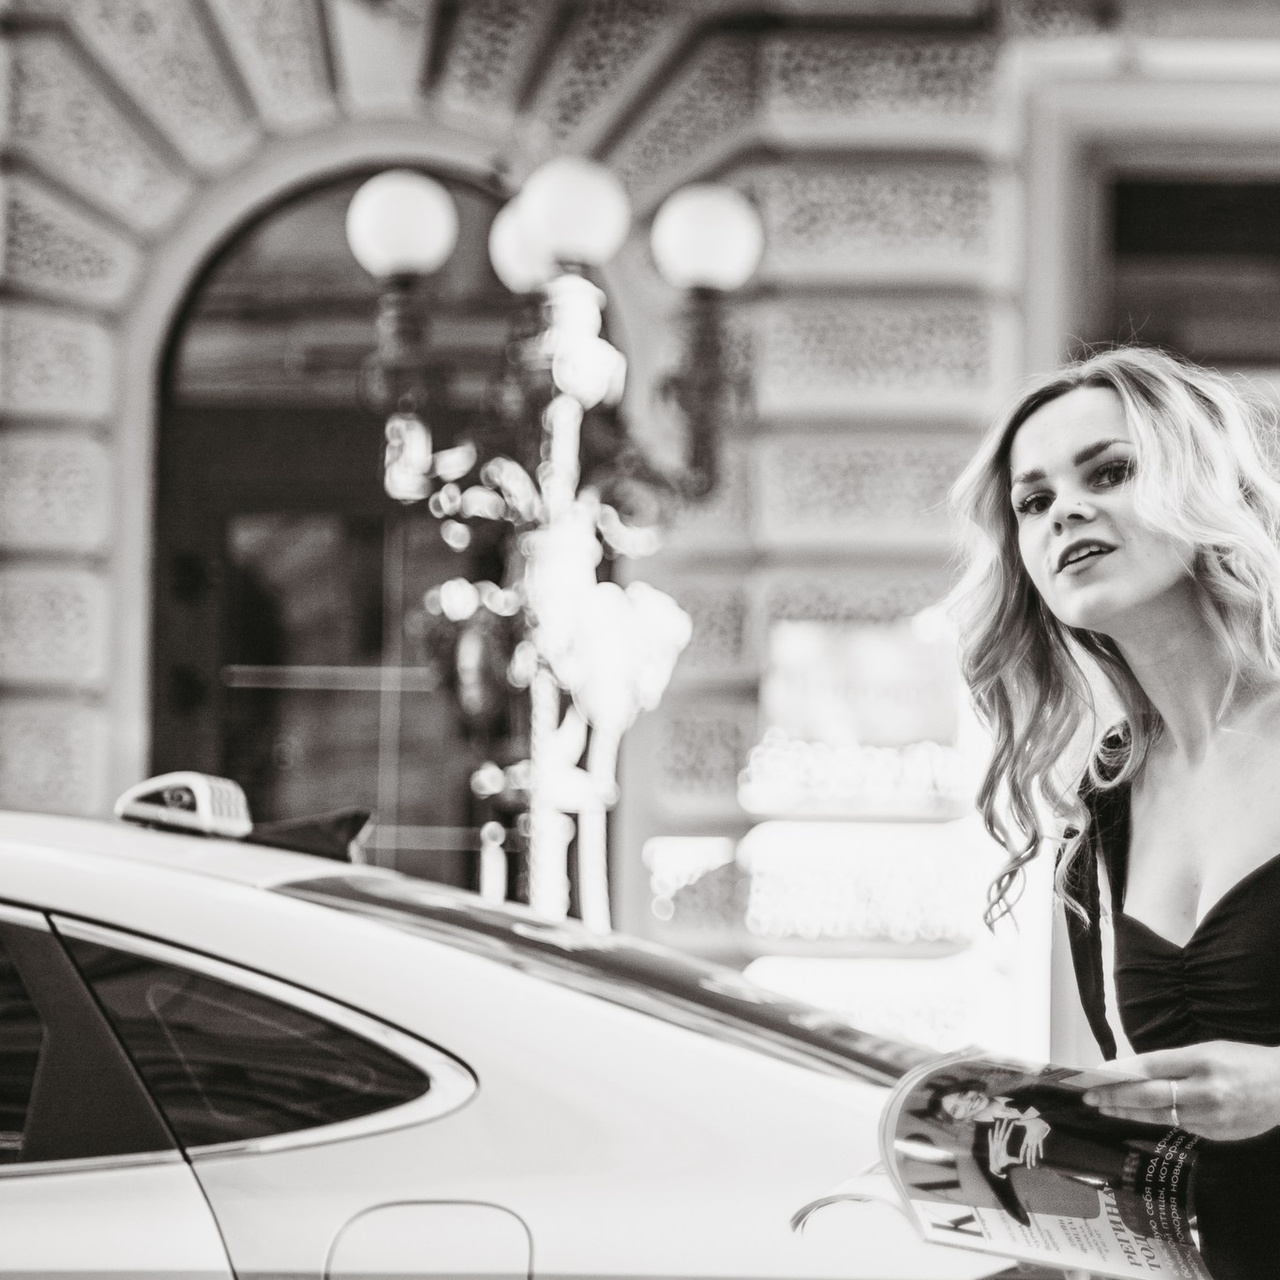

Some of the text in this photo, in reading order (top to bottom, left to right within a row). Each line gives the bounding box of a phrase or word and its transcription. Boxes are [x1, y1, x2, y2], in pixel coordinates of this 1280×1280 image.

[1145, 1157, 1160, 1182] под
[1158, 1135, 1186, 1182] которая
[1170, 1151, 1188, 1192] новые
[1142, 1186, 1155, 1216] себя
[1170, 1196, 1186, 1245] покоряя
[1103, 1188, 1143, 1268] РЕГИНА
